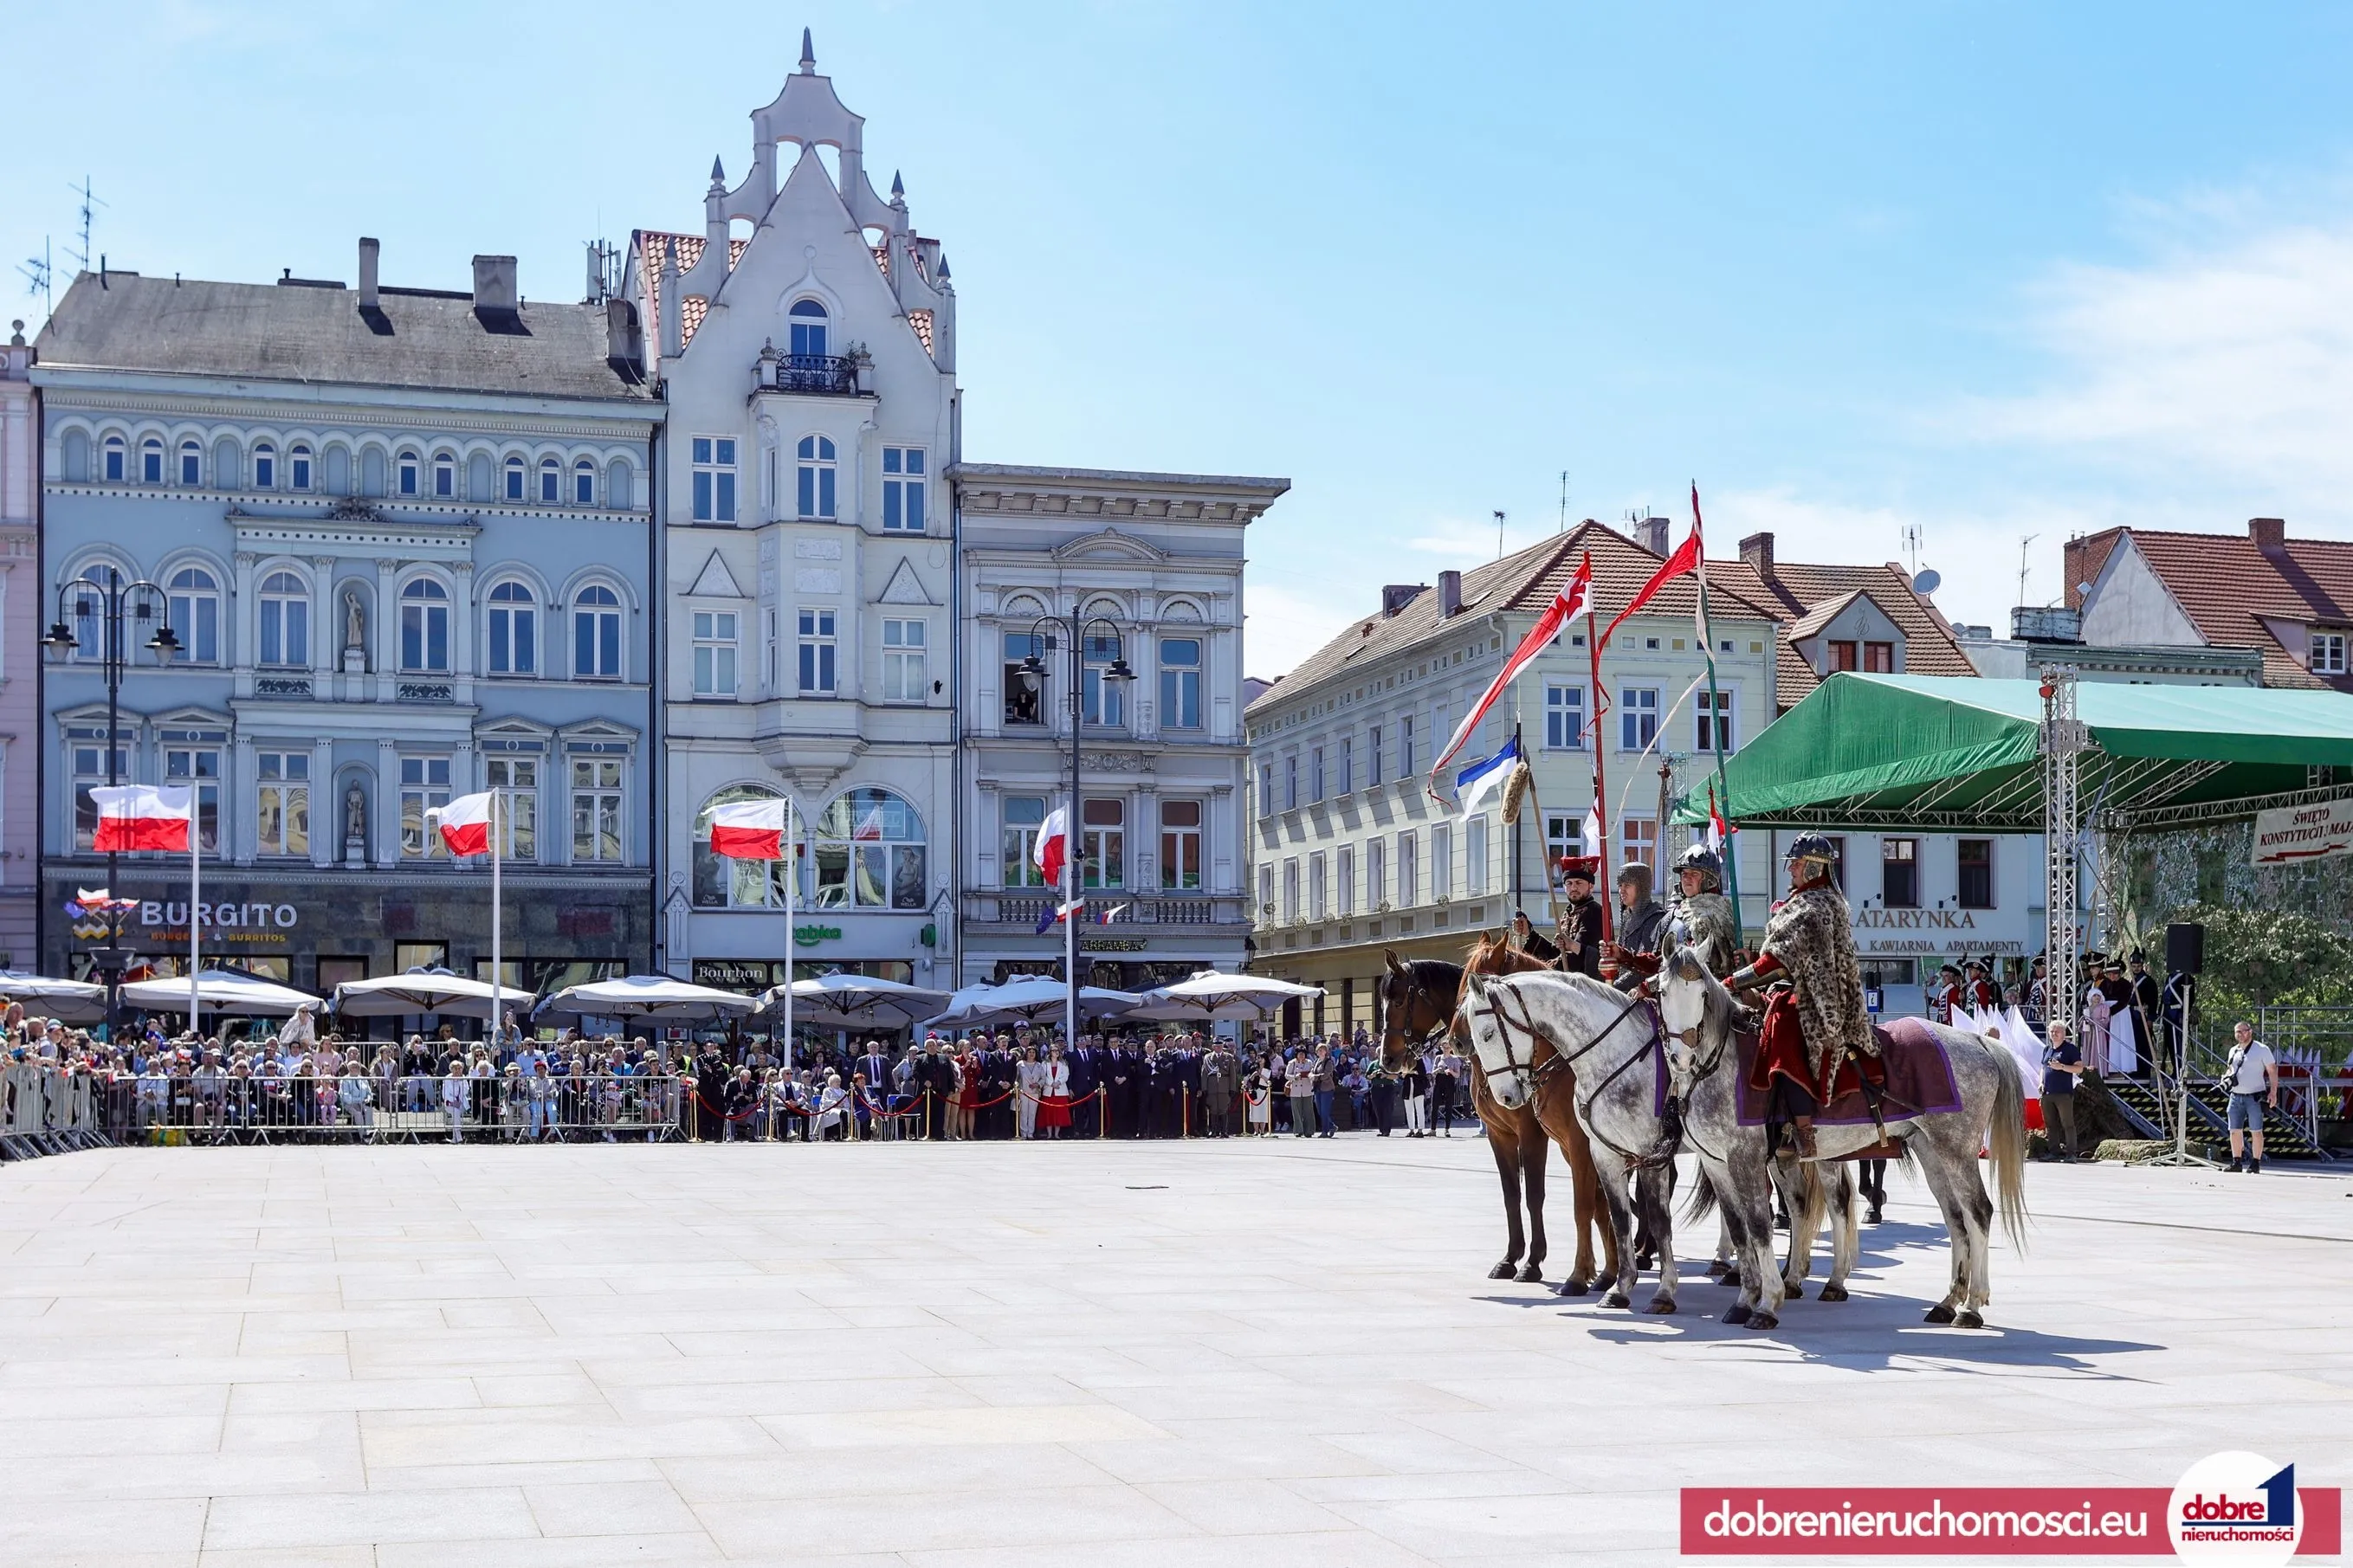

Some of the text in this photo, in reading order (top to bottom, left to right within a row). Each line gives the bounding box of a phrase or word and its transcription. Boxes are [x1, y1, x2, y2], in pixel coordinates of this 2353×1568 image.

[2292, 808, 2330, 825] ŚWIĘTO
[2259, 826, 2324, 846] KONSTYTUCJI
[141, 901, 297, 927] BURGITO
[1850, 910, 1975, 928] ATARYNKA
[151, 932, 205, 941] BURGES
[228, 933, 286, 942] BURRITOS
[793, 925, 842, 939] abka
[1870, 940, 1936, 951] KAWIARNIA
[1946, 941, 2023, 952] APARTAMENTY
[699, 966, 763, 978] Bourbon
